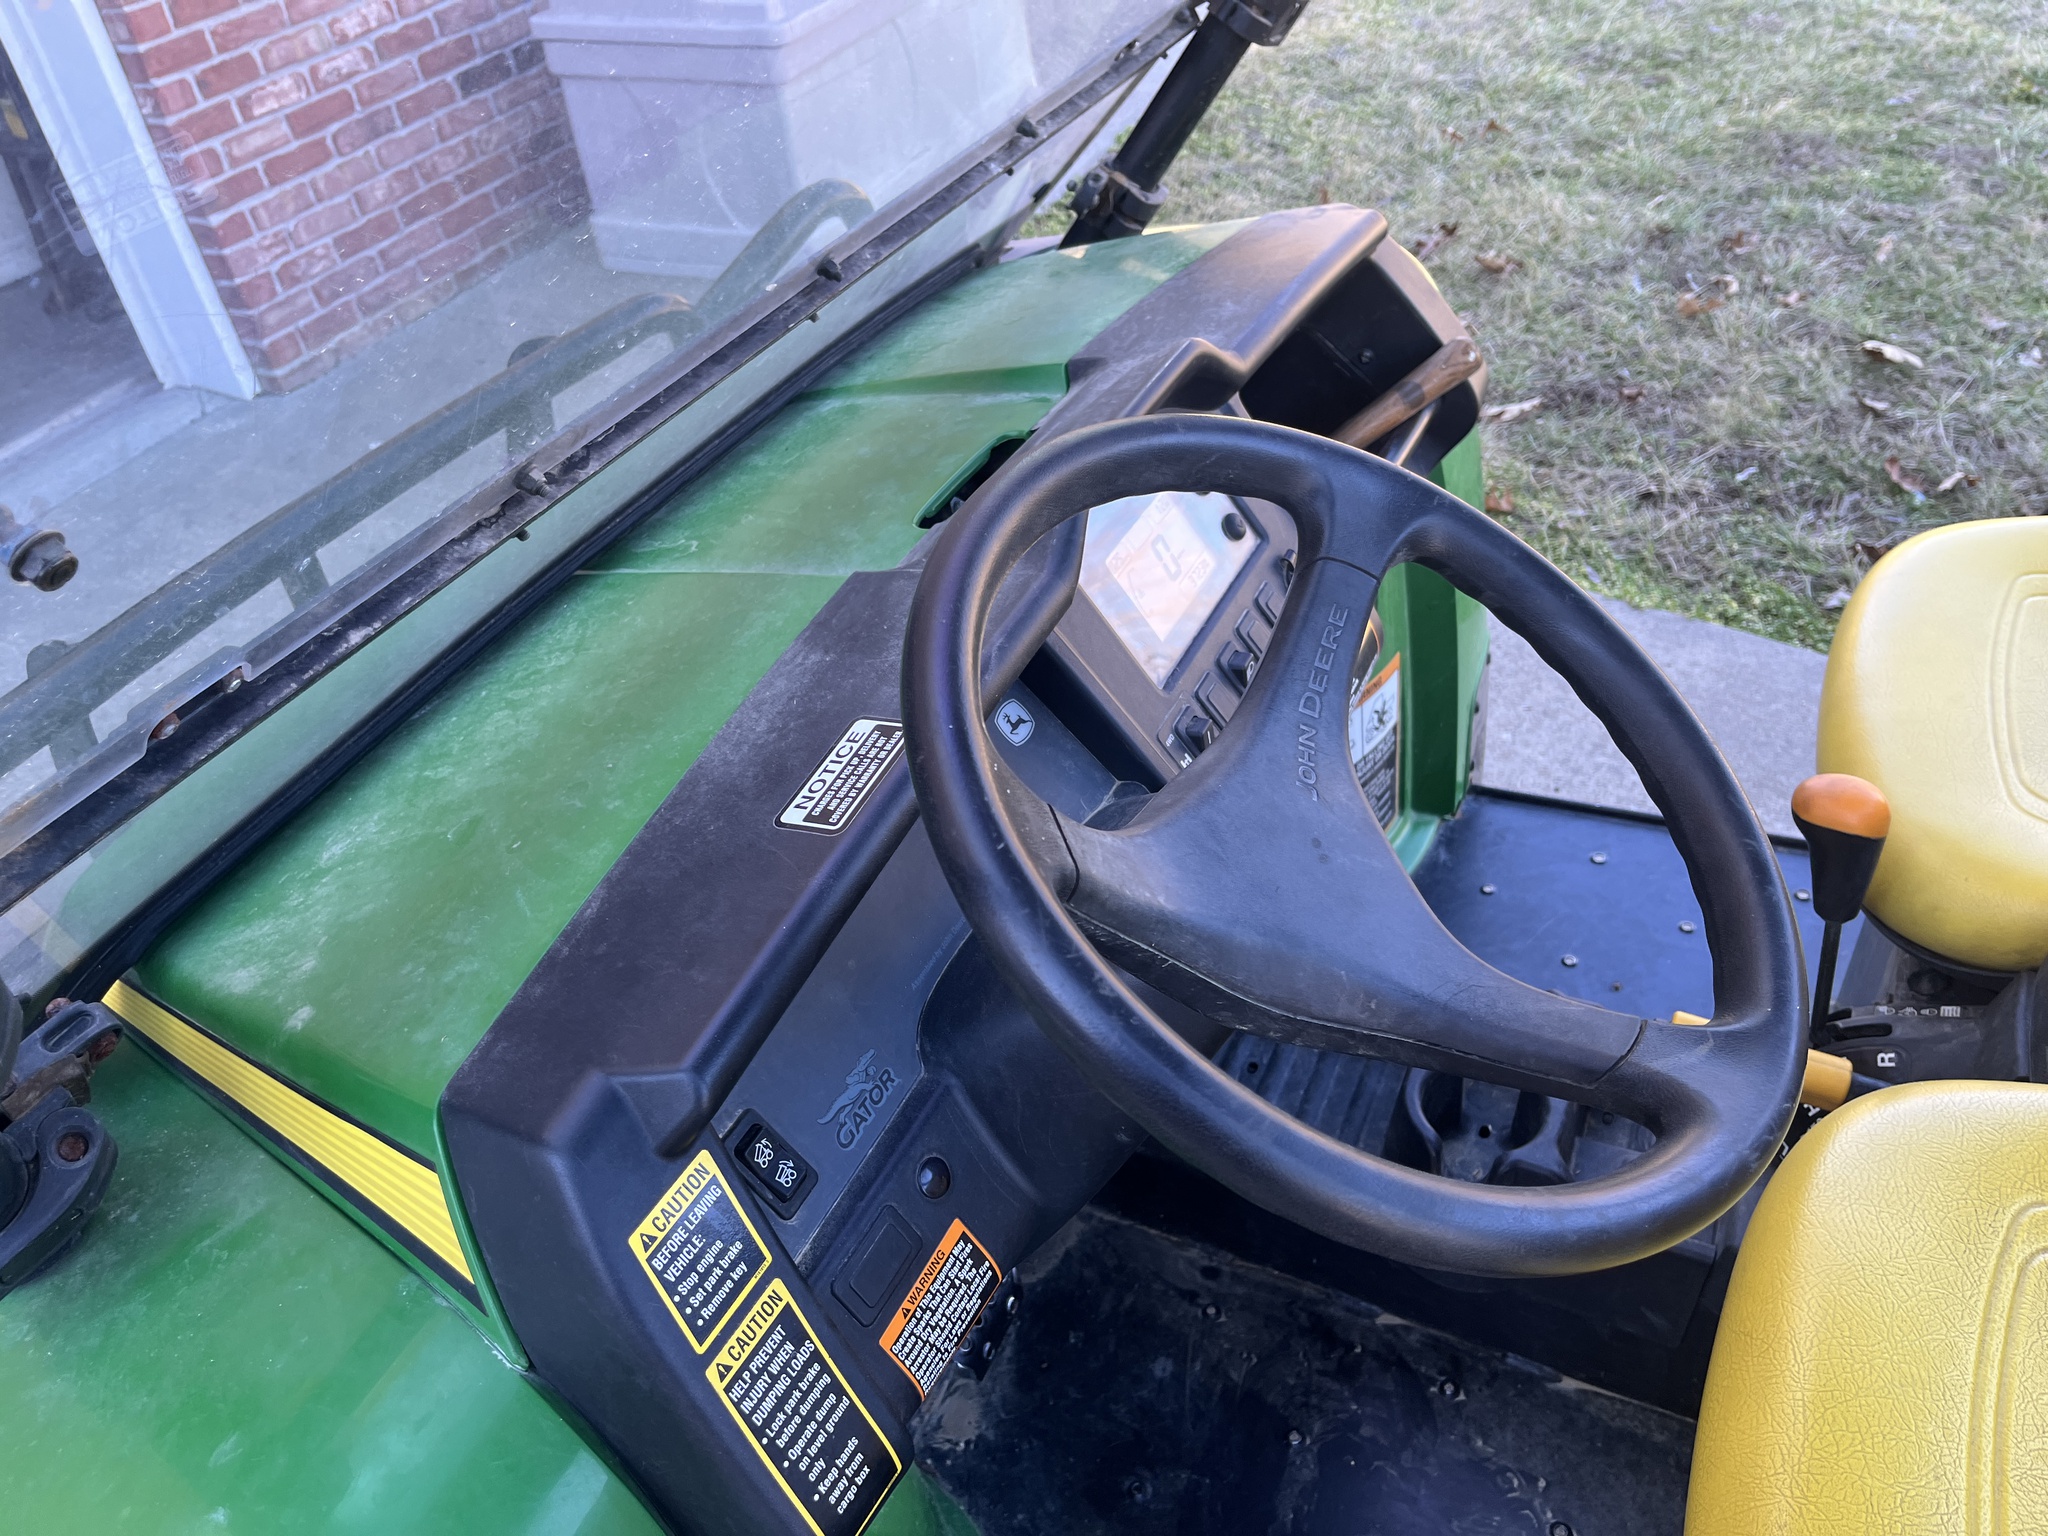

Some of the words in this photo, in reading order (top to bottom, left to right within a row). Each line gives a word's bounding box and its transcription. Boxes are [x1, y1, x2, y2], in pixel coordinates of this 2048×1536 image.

[1299, 603, 1348, 719] DEERE
[793, 731, 866, 810] NOTICE
[811, 791, 835, 816] CHARGES
[830, 779, 844, 790] FOR
[839, 765, 855, 778] PICK
[858, 730, 881, 755] DELIVERY
[827, 798, 840, 810] AND
[836, 775, 858, 798] SERVICE
[854, 758, 871, 775] CALLS
[866, 747, 880, 758] ARE
[875, 736, 887, 747] NOT
[1165, 733, 1175, 747] 4WD
[1296, 723, 1318, 802] JOHN
[829, 797, 853, 823] COVERED
[848, 788, 859, 797] BY
[854, 759, 881, 788] WARRANTY
[1876, 1052, 1896, 1067] R
[836, 1068, 895, 1149] GATOR
[651, 1226, 689, 1271] BEFORE
[684, 1185, 722, 1230] LEAVING
[652, 1162, 710, 1232] CAUTION
[663, 1234, 706, 1282] VEHICLE:
[677, 1272, 699, 1295] Stop
[697, 1240, 723, 1273] engine
[689, 1287, 707, 1307] Set
[704, 1266, 723, 1292] park
[718, 1241, 743, 1269] brake
[700, 1279, 734, 1319] Remove
[729, 1261, 748, 1281] key
[907, 1249, 946, 1305] WARNING
[963, 1270, 992, 1312] Regulations
[728, 1289, 783, 1361] CAUTION
[892, 1317, 917, 1354] Operation
[915, 1307, 923, 1318] of
[919, 1292, 933, 1309] This
[927, 1254, 956, 1294] Equipment
[952, 1240, 965, 1257] May
[898, 1335, 916, 1361] Create
[913, 1310, 932, 1336] Sparks
[928, 1292, 943, 1310] That
[939, 1279, 951, 1294] Can
[948, 1260, 962, 1280] Start
[958, 1243, 973, 1262] Fires
[904, 1339, 924, 1368] Around
[920, 1325, 932, 1341] Dry
[928, 1288, 957, 1326] Vegetation.
[954, 1278, 961, 1287] A
[958, 1258, 973, 1280] Spark
[910, 1343, 931, 1375] Arrestor
[928, 1326, 941, 1344] May
[938, 1315, 947, 1328] be
[944, 1283, 969, 1318] Required.
[965, 1267, 977, 1282] The
[915, 1347, 937, 1380] Operator
[935, 1320, 953, 1348] Should
[951, 1294, 970, 1322] Contact
[964, 1274, 981, 1296] Local
[978, 1260, 990, 1276] Fire
[948, 1319, 962, 1340] Laws
[961, 1310, 967, 1320] or
[728, 1371, 751, 1402] HELP
[749, 1324, 786, 1374] PREVENT
[740, 1371, 772, 1414] INJURY
[767, 1341, 795, 1375] WHEN
[918, 1352, 942, 1386] Agencies
[940, 1338, 949, 1353] For
[752, 1374, 791, 1426] DUMPING
[786, 1340, 815, 1377] LOADS
[765, 1411, 787, 1437] Lock
[784, 1389, 802, 1415] park
[798, 1363, 821, 1391] brake
[775, 1415, 801, 1448] before
[799, 1373, 831, 1416] dumping
[788, 1421, 818, 1460] Operate
[815, 1393, 836, 1421] dump
[799, 1456, 811, 1471] on
[807, 1429, 828, 1457] level
[825, 1395, 850, 1433] ground
[808, 1458, 826, 1482] only
[818, 1467, 839, 1494] Keep
[835, 1437, 858, 1468] hands
[829, 1476, 849, 1504] away
[845, 1452, 864, 1477] from
[837, 1485, 857, 1514] cargo
[854, 1465, 870, 1485] box
